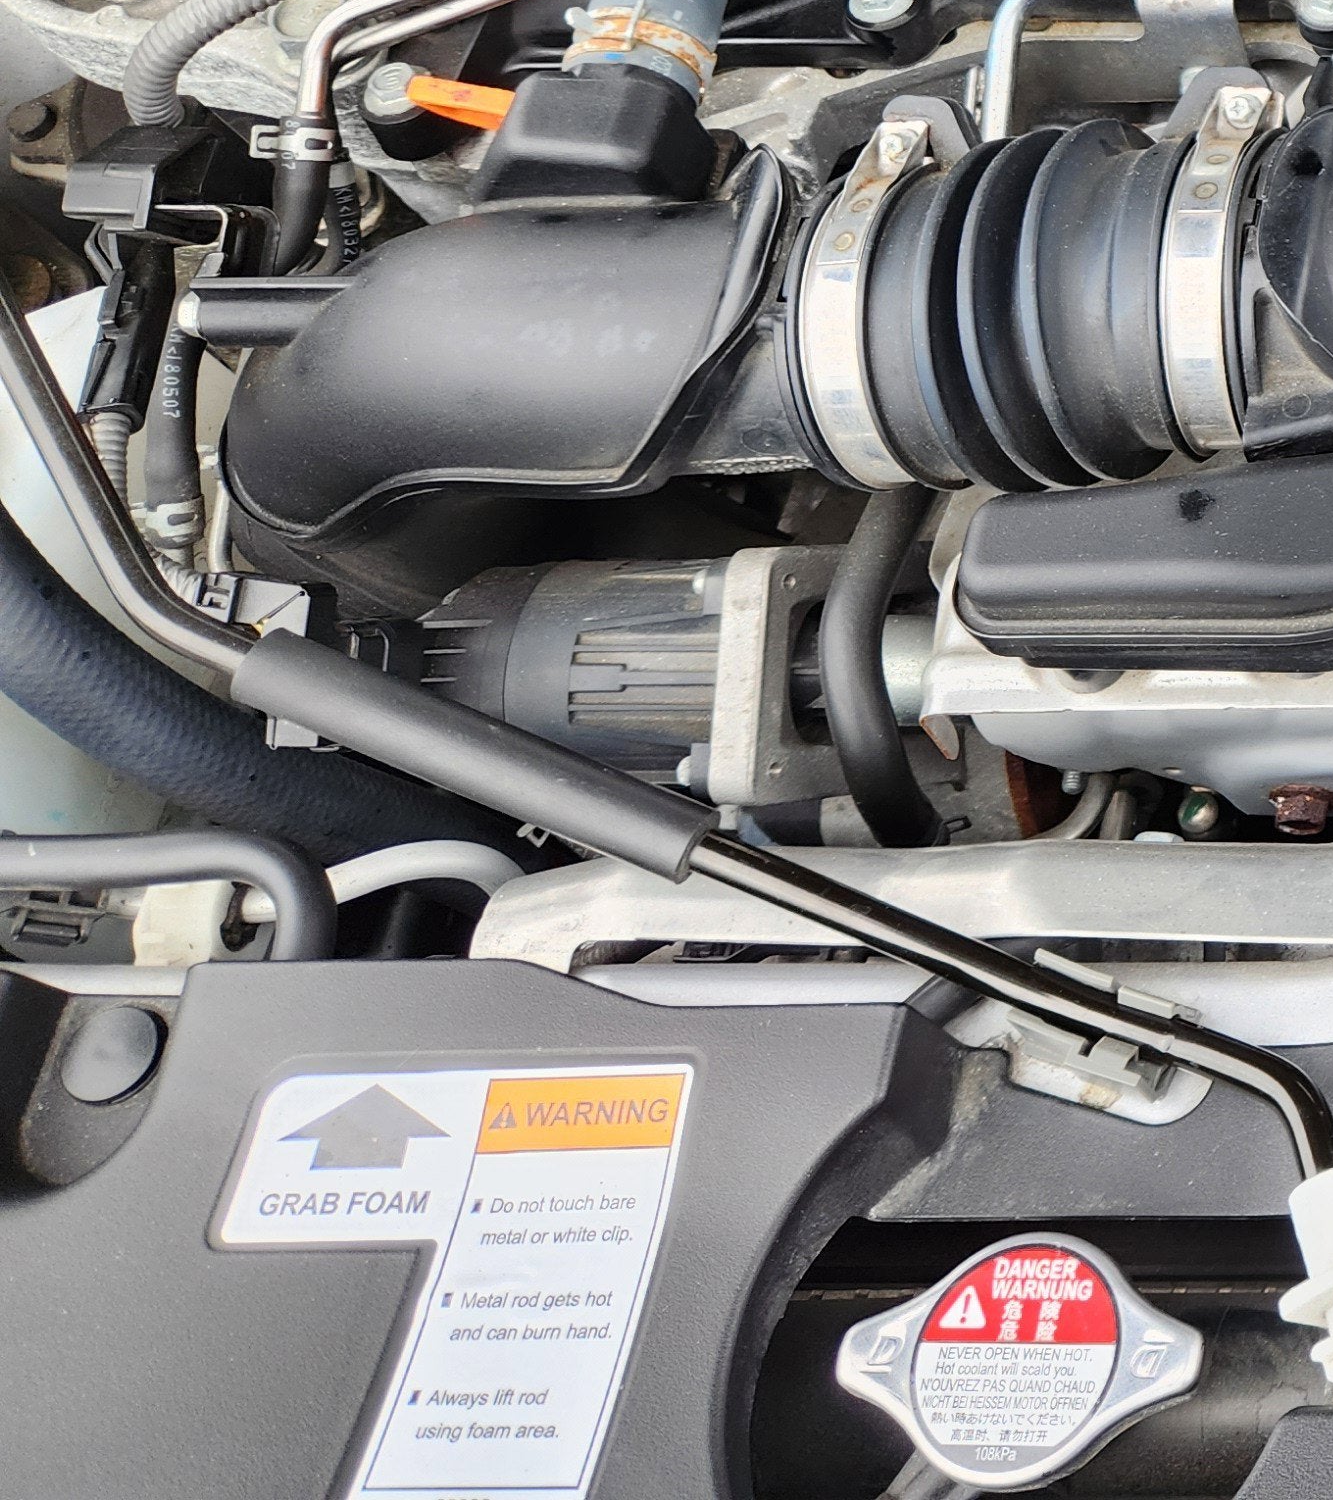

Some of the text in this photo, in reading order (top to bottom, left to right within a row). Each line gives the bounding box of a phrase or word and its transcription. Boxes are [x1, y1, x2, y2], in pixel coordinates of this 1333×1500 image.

[526, 1099, 669, 1127] WARNING
[259, 1190, 430, 1217] GRAB FOAM
[490, 1194, 637, 1214] Do not touch bare
[481, 1225, 634, 1245] metal or white clip.
[993, 1257, 1079, 1279] DANGER
[460, 1290, 614, 1311] Metal rod gets hot
[991, 1280, 1094, 1301] WARNUNG
[449, 1323, 612, 1341] and can burn hand.
[938, 1346, 1093, 1362] NEVER OPEN WHEN HOT.
[935, 1361, 1077, 1380] Hot coolant will scald you.
[920, 1378, 981, 1392] N'OUVREZ
[982, 1379, 1006, 1392] PAS
[1009, 1380, 1051, 1393] QUAND
[426, 1389, 549, 1410] Always lift rod
[922, 1395, 952, 1409] NICHT
[953, 1396, 967, 1409] BEI
[969, 1396, 1013, 1409] HEISSEM
[1013, 1396, 1047, 1410] MOTOR
[415, 1422, 560, 1442] using foam area.
[975, 1447, 1018, 1462] 108kPa
